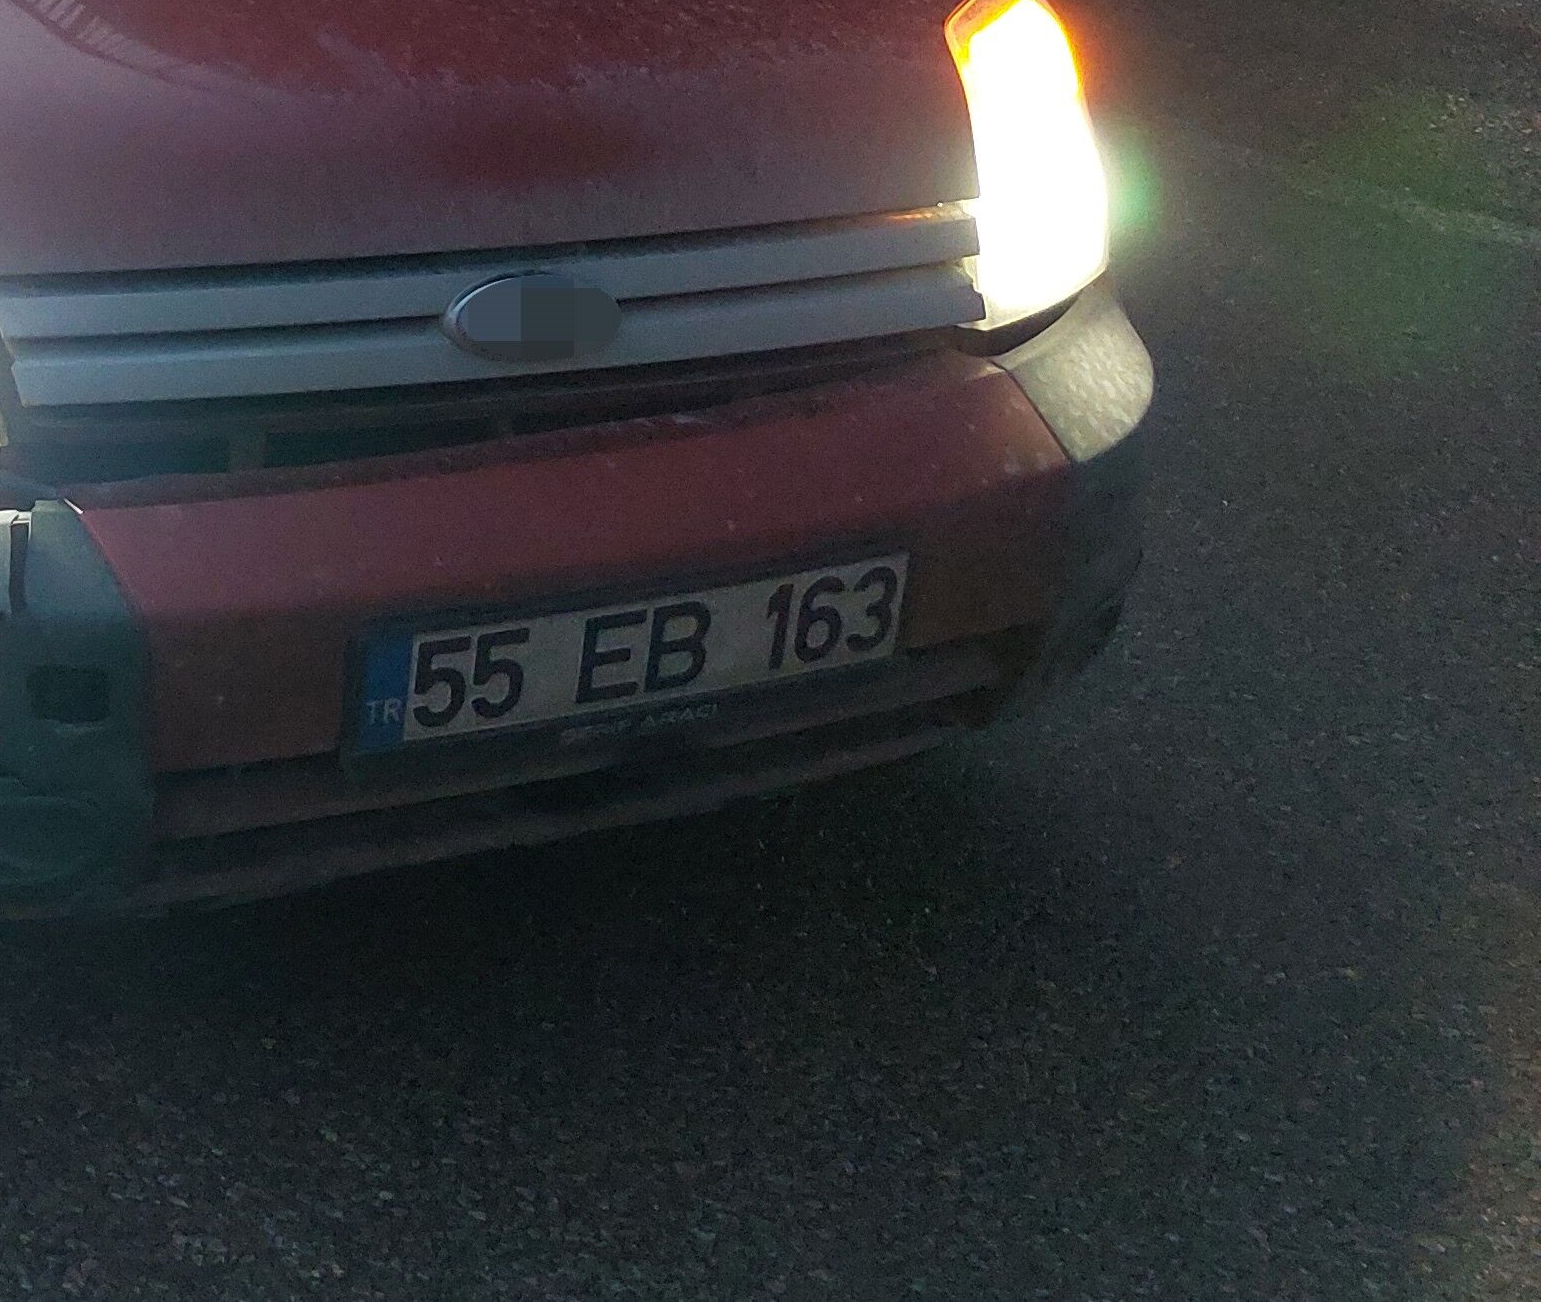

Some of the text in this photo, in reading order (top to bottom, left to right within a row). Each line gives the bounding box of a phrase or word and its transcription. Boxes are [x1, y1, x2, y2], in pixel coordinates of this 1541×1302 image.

[366, 566, 898, 728] TR 55 EB 163
